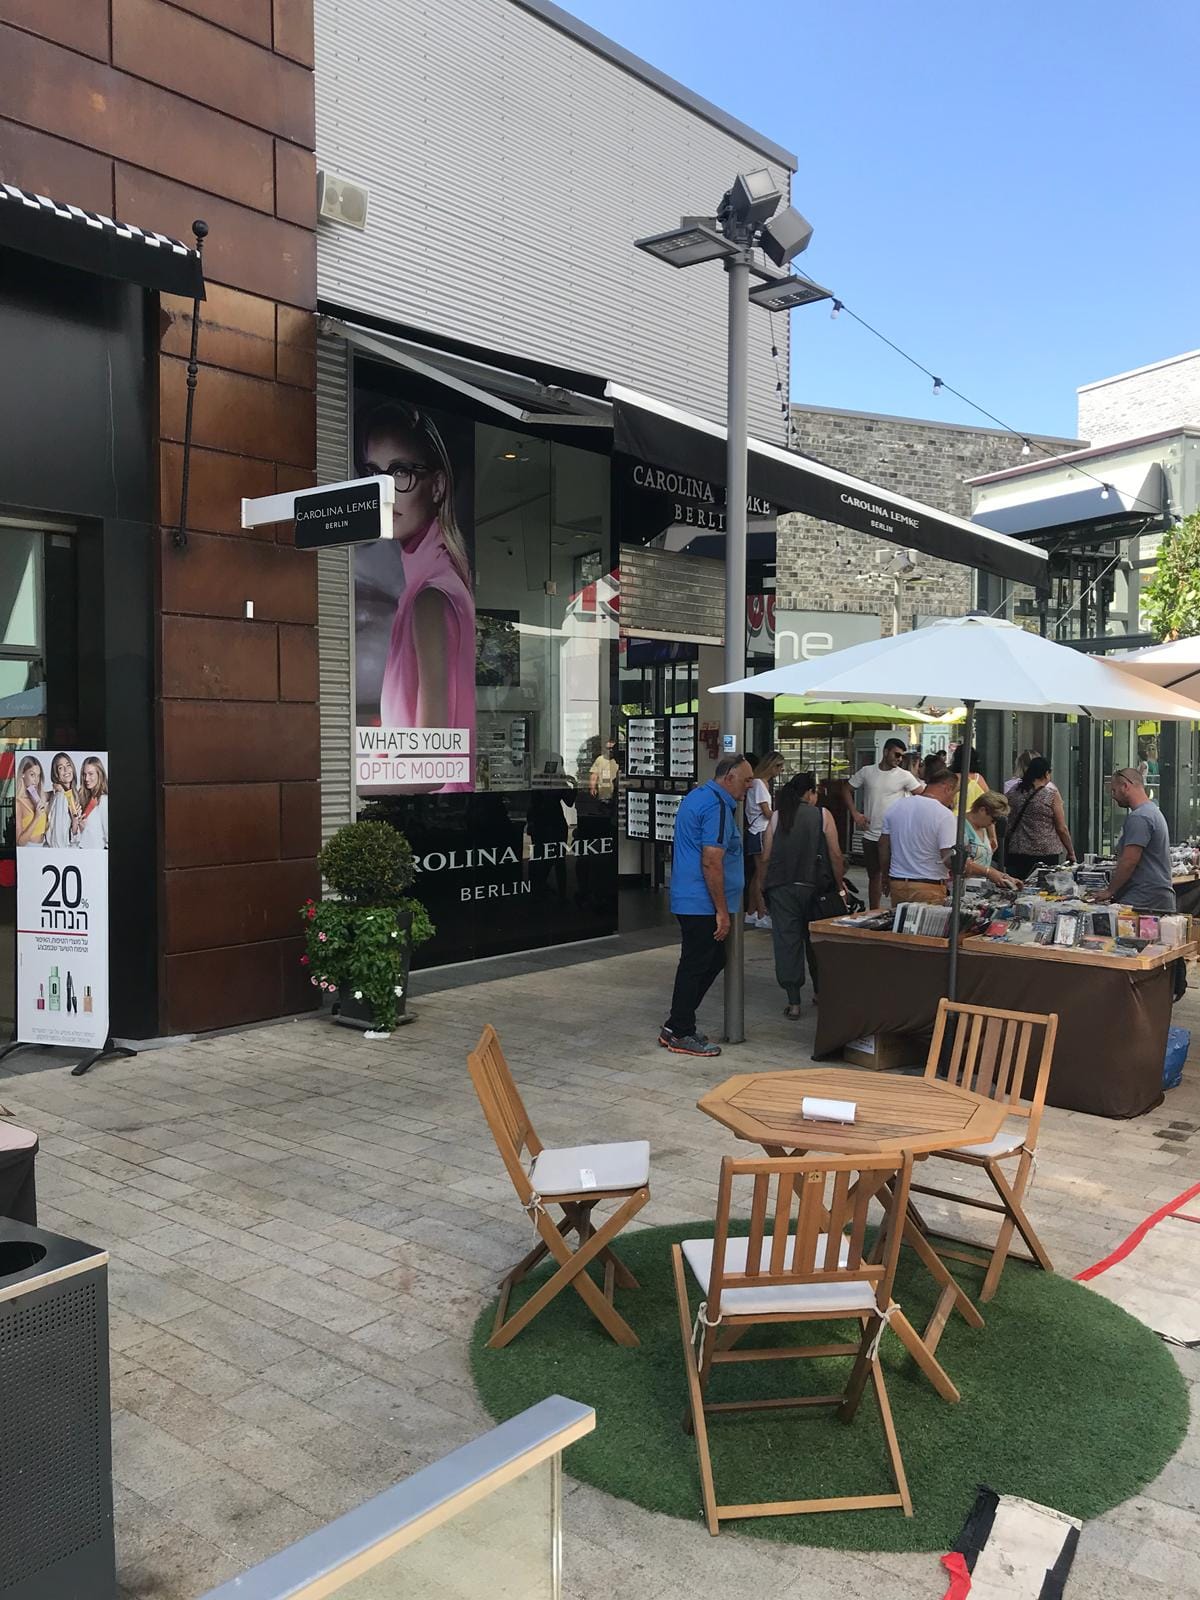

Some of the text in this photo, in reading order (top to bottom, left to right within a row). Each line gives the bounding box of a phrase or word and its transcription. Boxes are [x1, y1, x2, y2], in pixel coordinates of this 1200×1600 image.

[633, 465, 714, 501] CAROLINA
[296, 499, 378, 521] CAROLINA LEMKE
[675, 503, 724, 528] BERLI
[840, 493, 920, 529] CAROLINA LEMKE
[325, 520, 349, 530] BERLIN
[870, 520, 894, 533] BERLIN
[359, 731, 462, 750] WHAT'S YOUR
[361, 761, 465, 780] OPTIC MOOD?
[528, 837, 614, 862] LEMKE
[460, 879, 533, 902] BERLIN
[41, 909, 88, 930] הנחה
